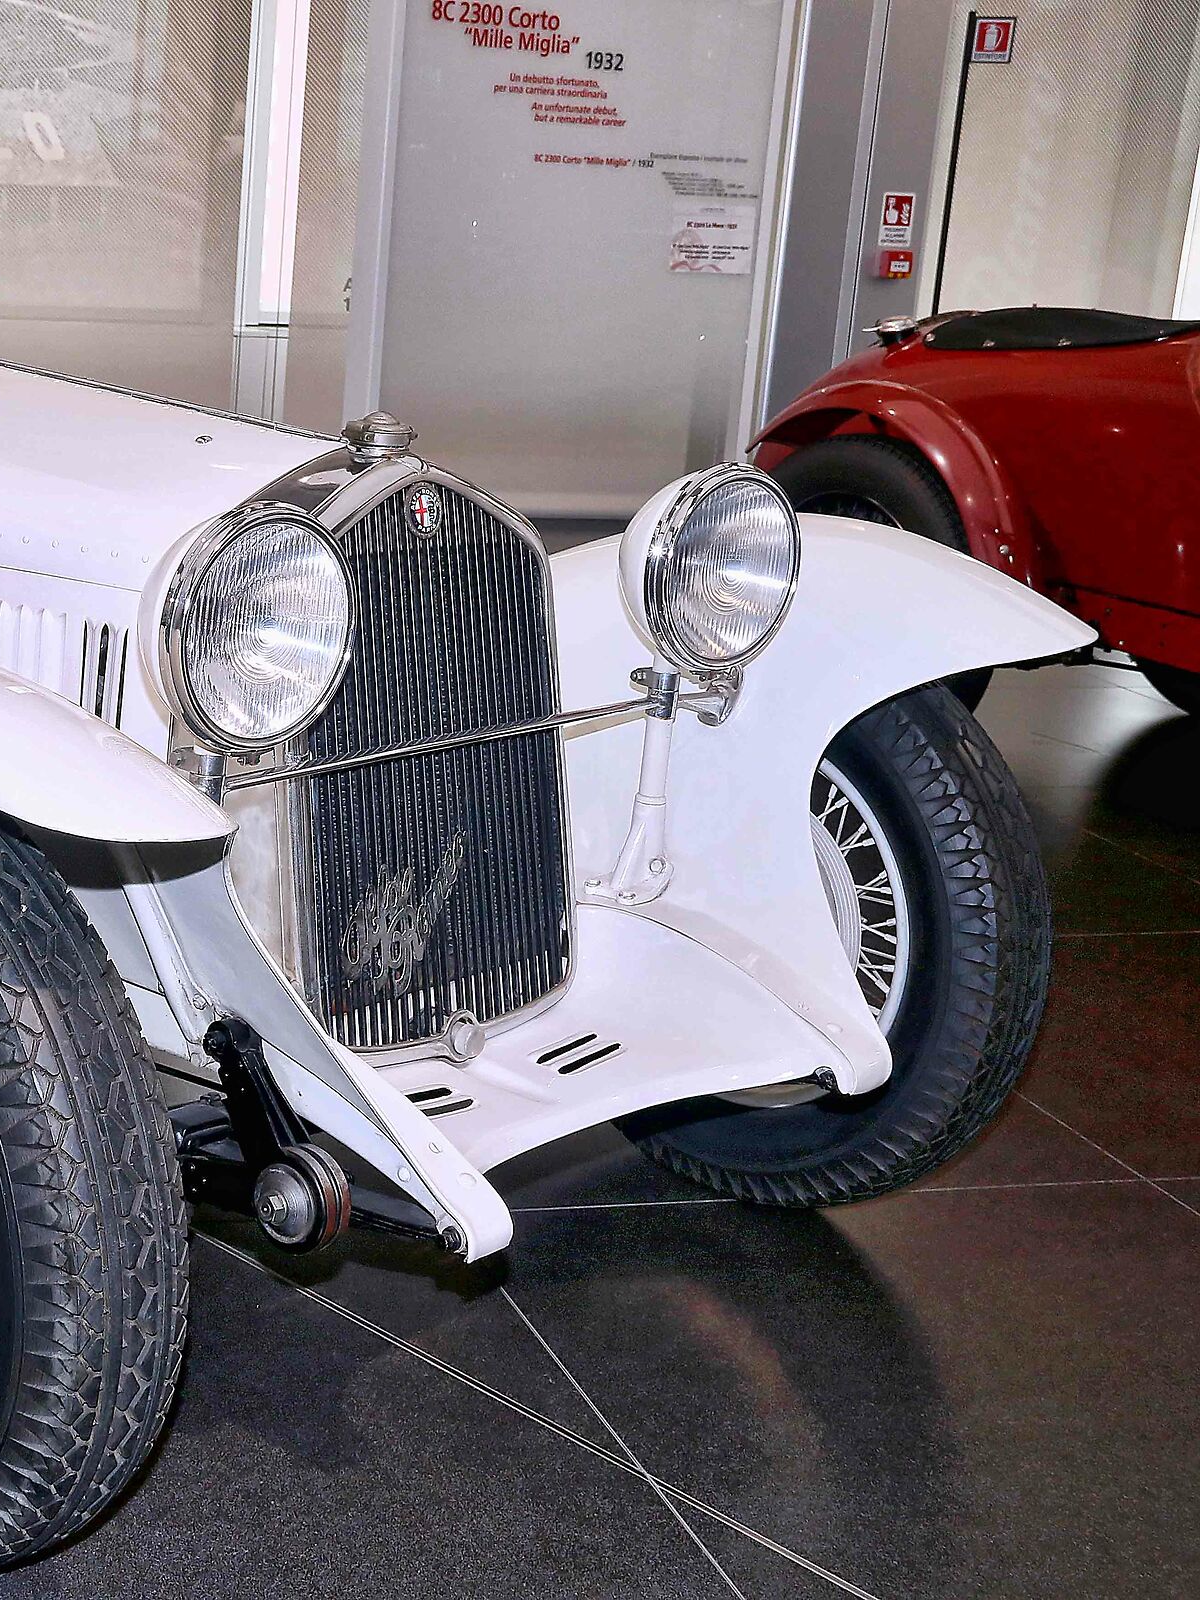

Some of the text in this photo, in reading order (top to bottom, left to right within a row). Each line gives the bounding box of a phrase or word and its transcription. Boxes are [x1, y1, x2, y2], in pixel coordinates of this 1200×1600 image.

[431, 0, 560, 31] 8C 2300 Corto
[585, 51, 625, 72] 1932
[509, 73, 521, 82] Un
[522, 73, 554, 85] debutto
[493, 84, 608, 100] per una carriera straordinaria
[531, 102, 543, 111] An
[544, 102, 592, 115] unfortunate
[534, 113, 627, 127] but a remarkable career
[534, 153, 544, 163] 8C
[544, 154, 561, 164] 2300
[562, 155, 582, 165] Corto
[638, 159, 655, 168] 1932
